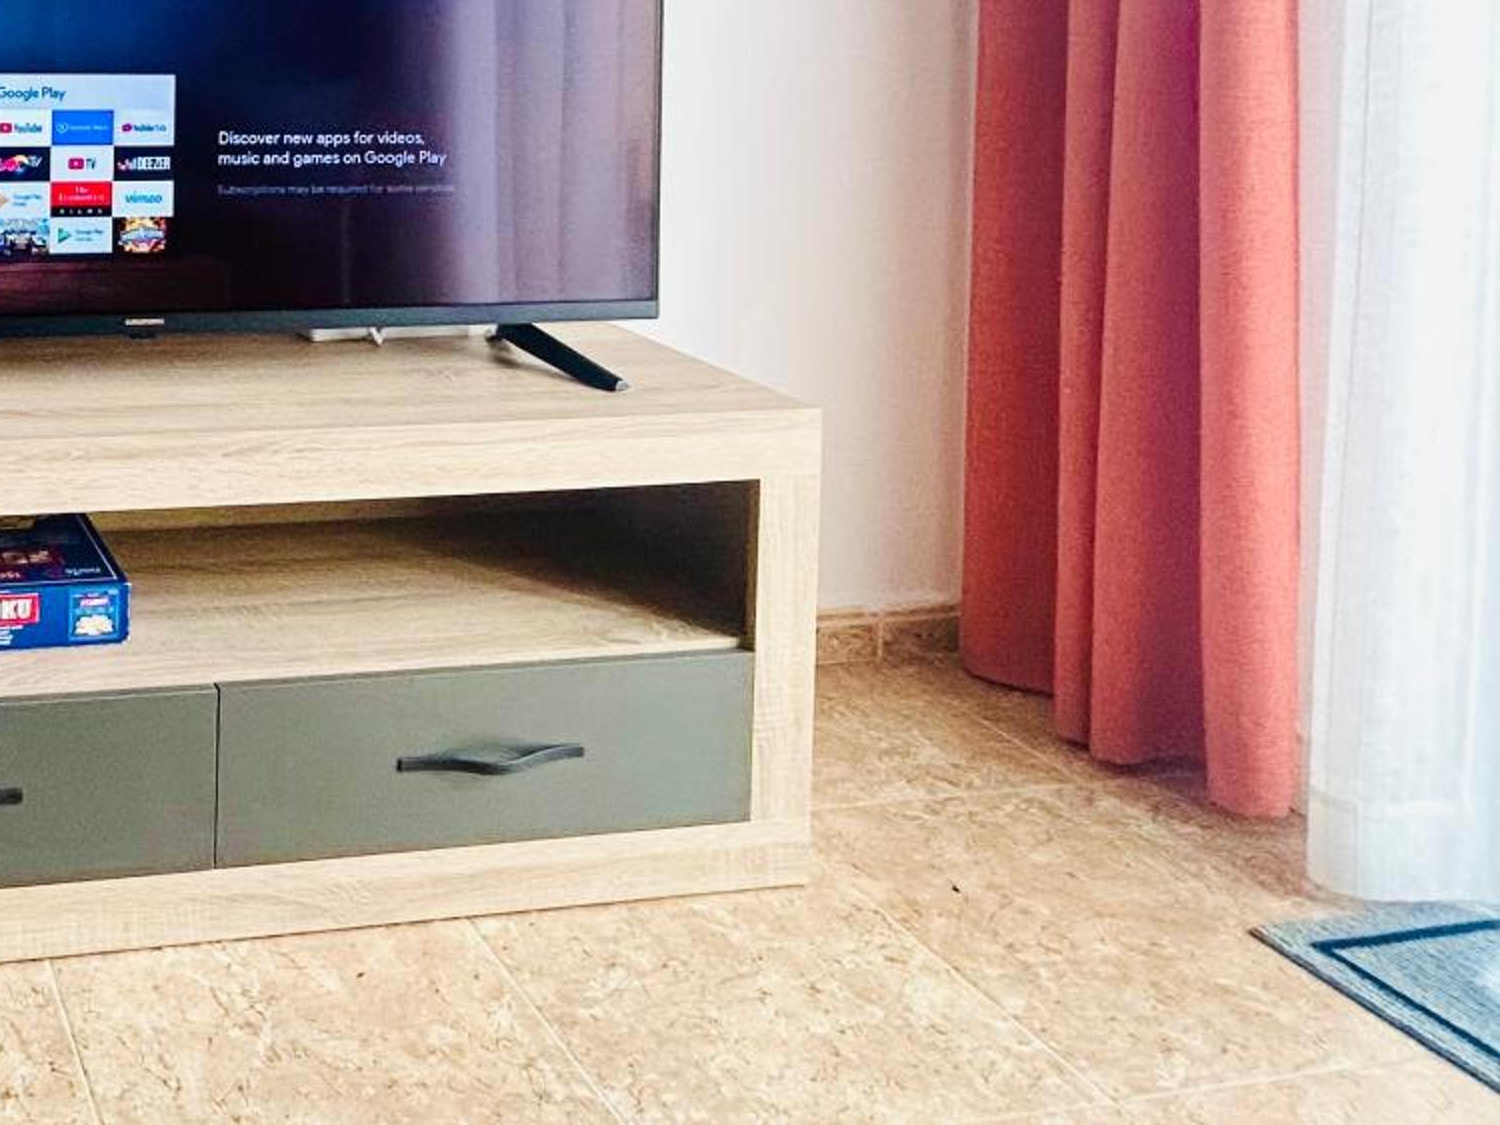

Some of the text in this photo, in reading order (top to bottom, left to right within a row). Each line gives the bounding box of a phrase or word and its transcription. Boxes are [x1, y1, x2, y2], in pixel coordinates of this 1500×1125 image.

[41, 86, 67, 102] Play
[218, 130, 425, 148] Discover new apps for videos,
[137, 156, 171, 170] DEEZER
[217, 150, 447, 168] music and games on Google Play
[125, 191, 163, 204] vimeo
